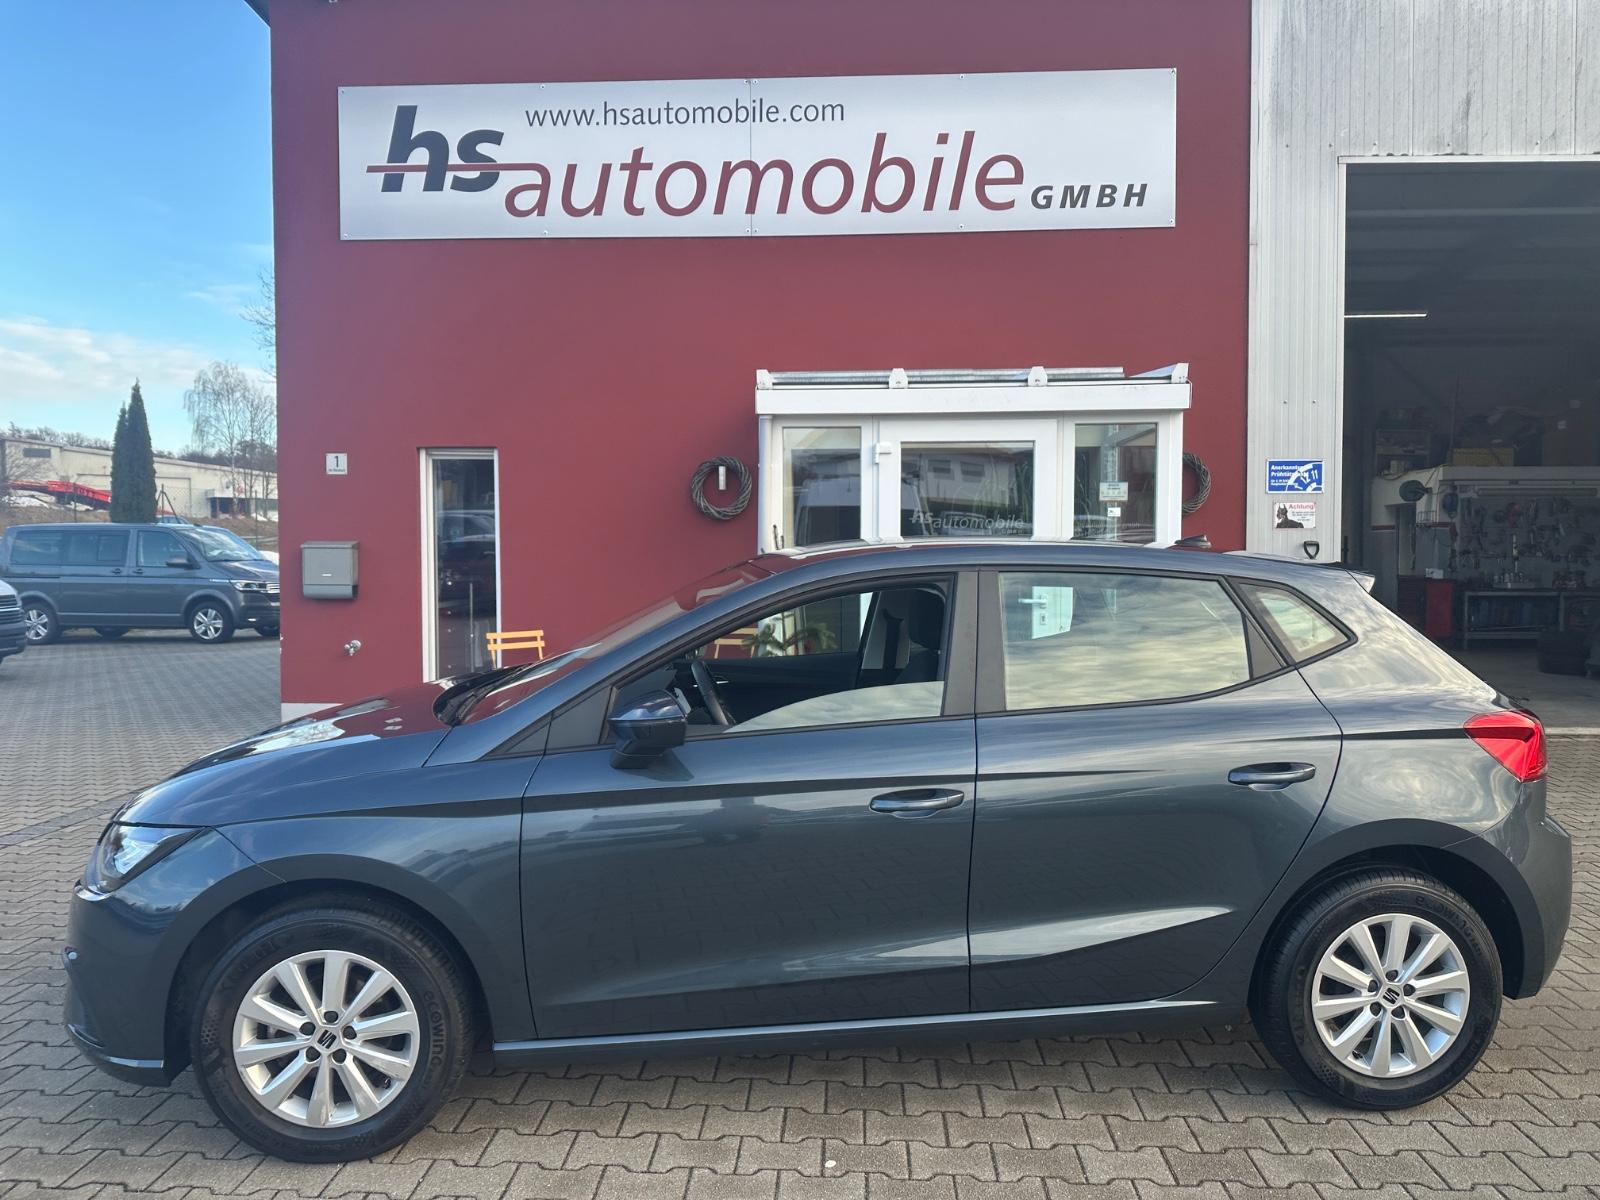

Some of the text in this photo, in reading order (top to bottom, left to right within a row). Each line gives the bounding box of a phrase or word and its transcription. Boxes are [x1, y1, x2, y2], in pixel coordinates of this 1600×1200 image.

[525, 97, 845, 127] www.hsautomobile.com
[380, 105, 1148, 218] hs automobile GMBH
[334, 455, 339, 468] 1
[933, 514, 1024, 529] automobile
